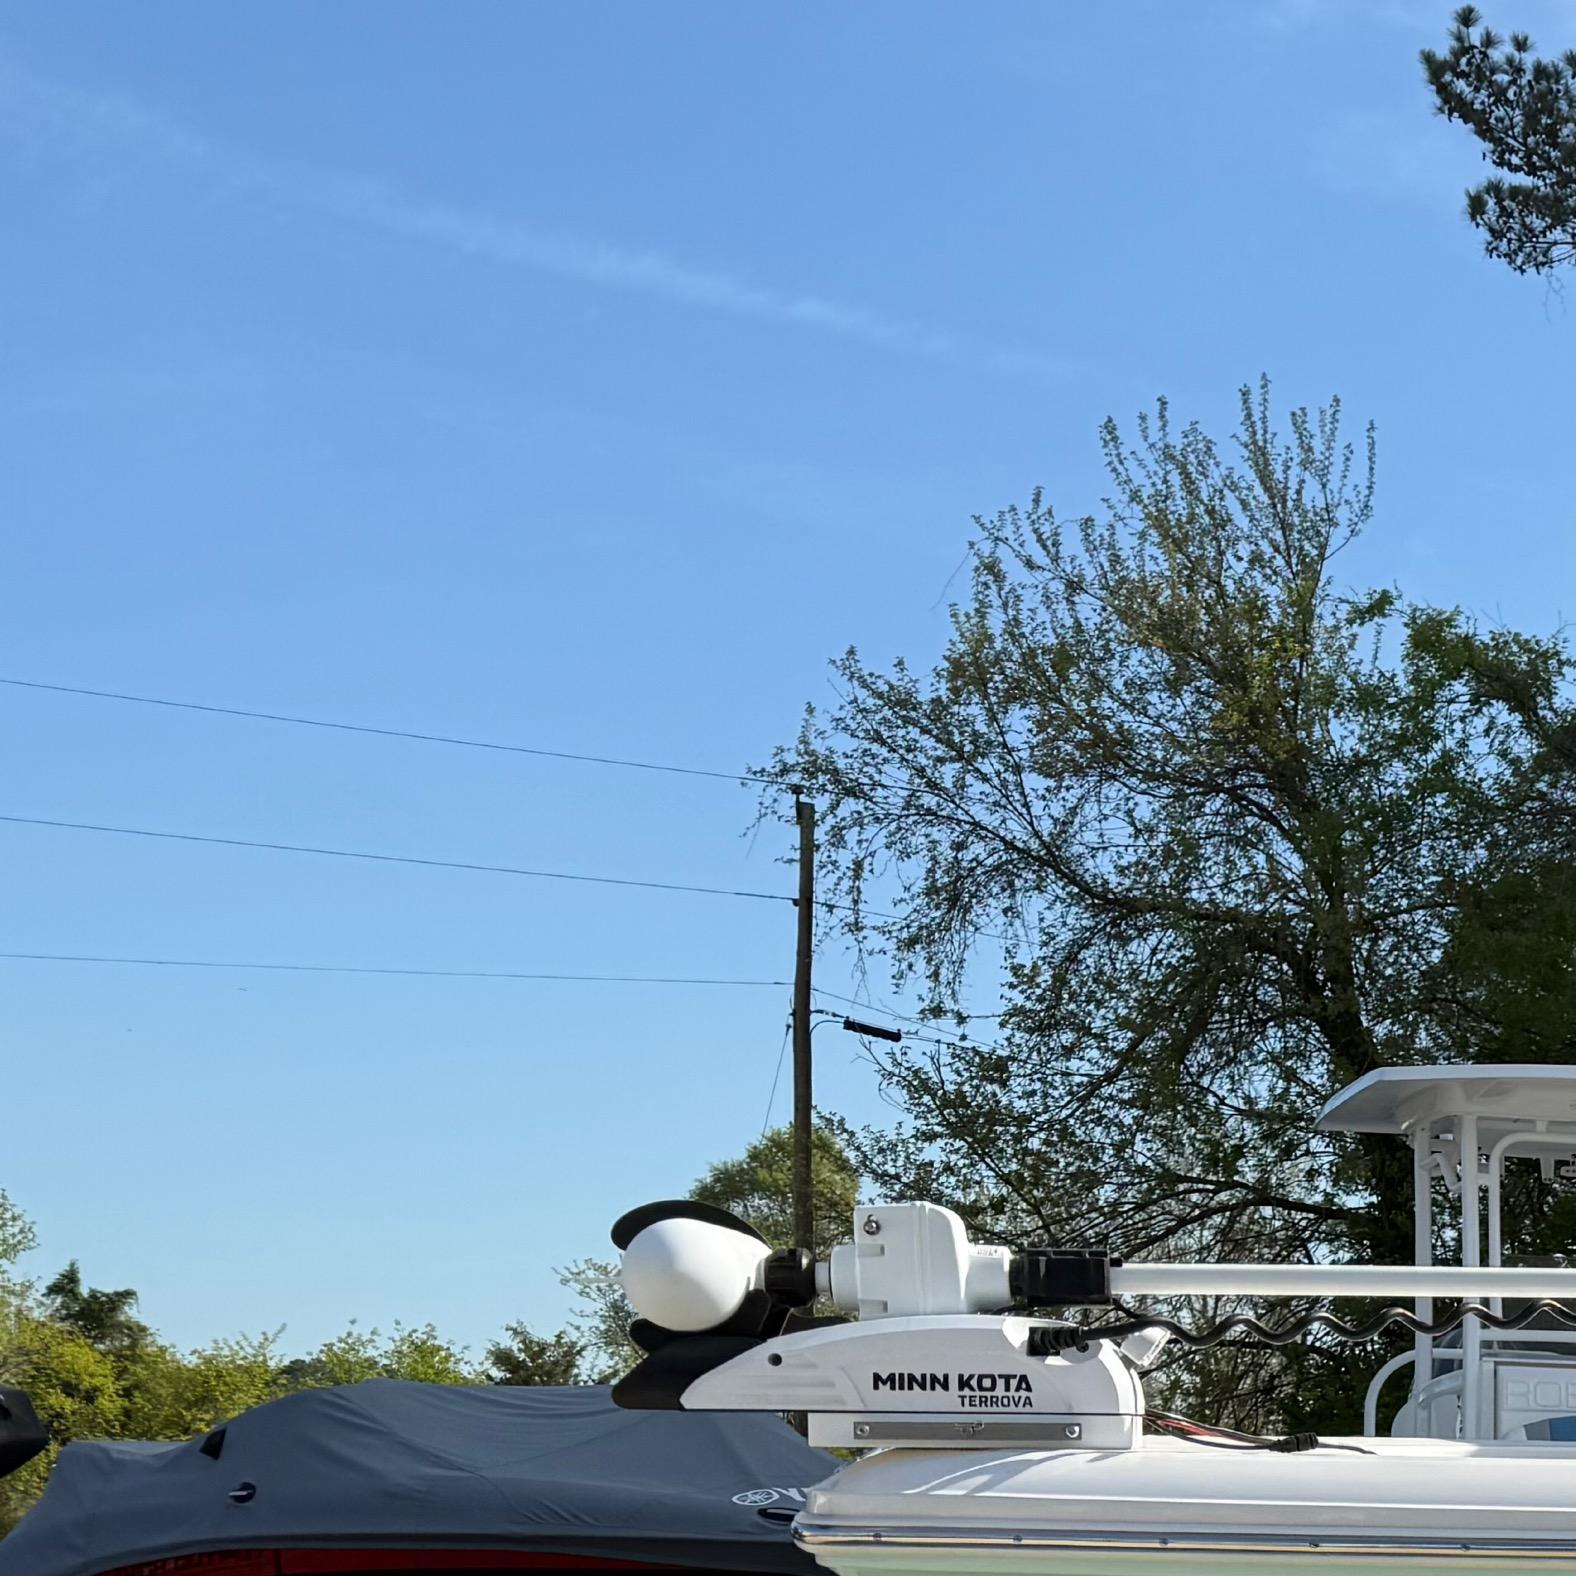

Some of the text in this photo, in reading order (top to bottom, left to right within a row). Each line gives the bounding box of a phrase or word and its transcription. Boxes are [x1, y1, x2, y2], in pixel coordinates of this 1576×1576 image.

[872, 1372, 1033, 1393] MINN KOTA
[958, 1395, 1033, 1408] TERROVA
